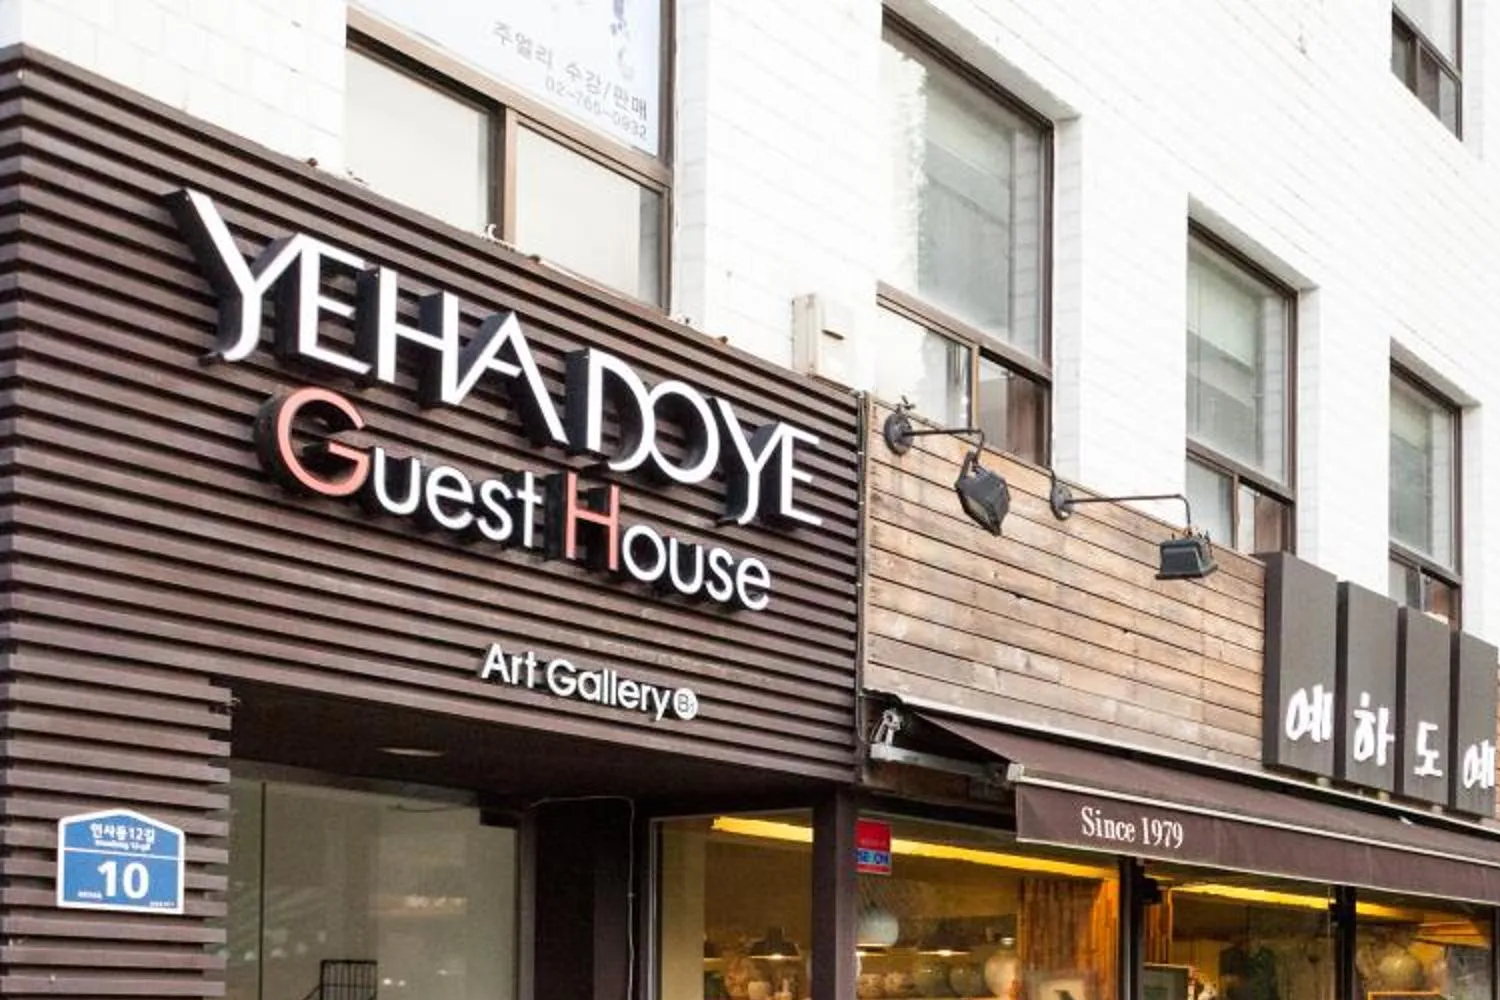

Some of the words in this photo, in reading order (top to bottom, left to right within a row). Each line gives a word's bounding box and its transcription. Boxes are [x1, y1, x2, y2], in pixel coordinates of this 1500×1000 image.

[277, 387, 542, 547] Guest
[565, 472, 772, 611] House
[481, 643, 537, 688] Art
[547, 659, 671, 721] Gallery
[1080, 805, 1136, 843] Since
[1141, 817, 1184, 849] 1979
[97, 860, 150, 899] 10
